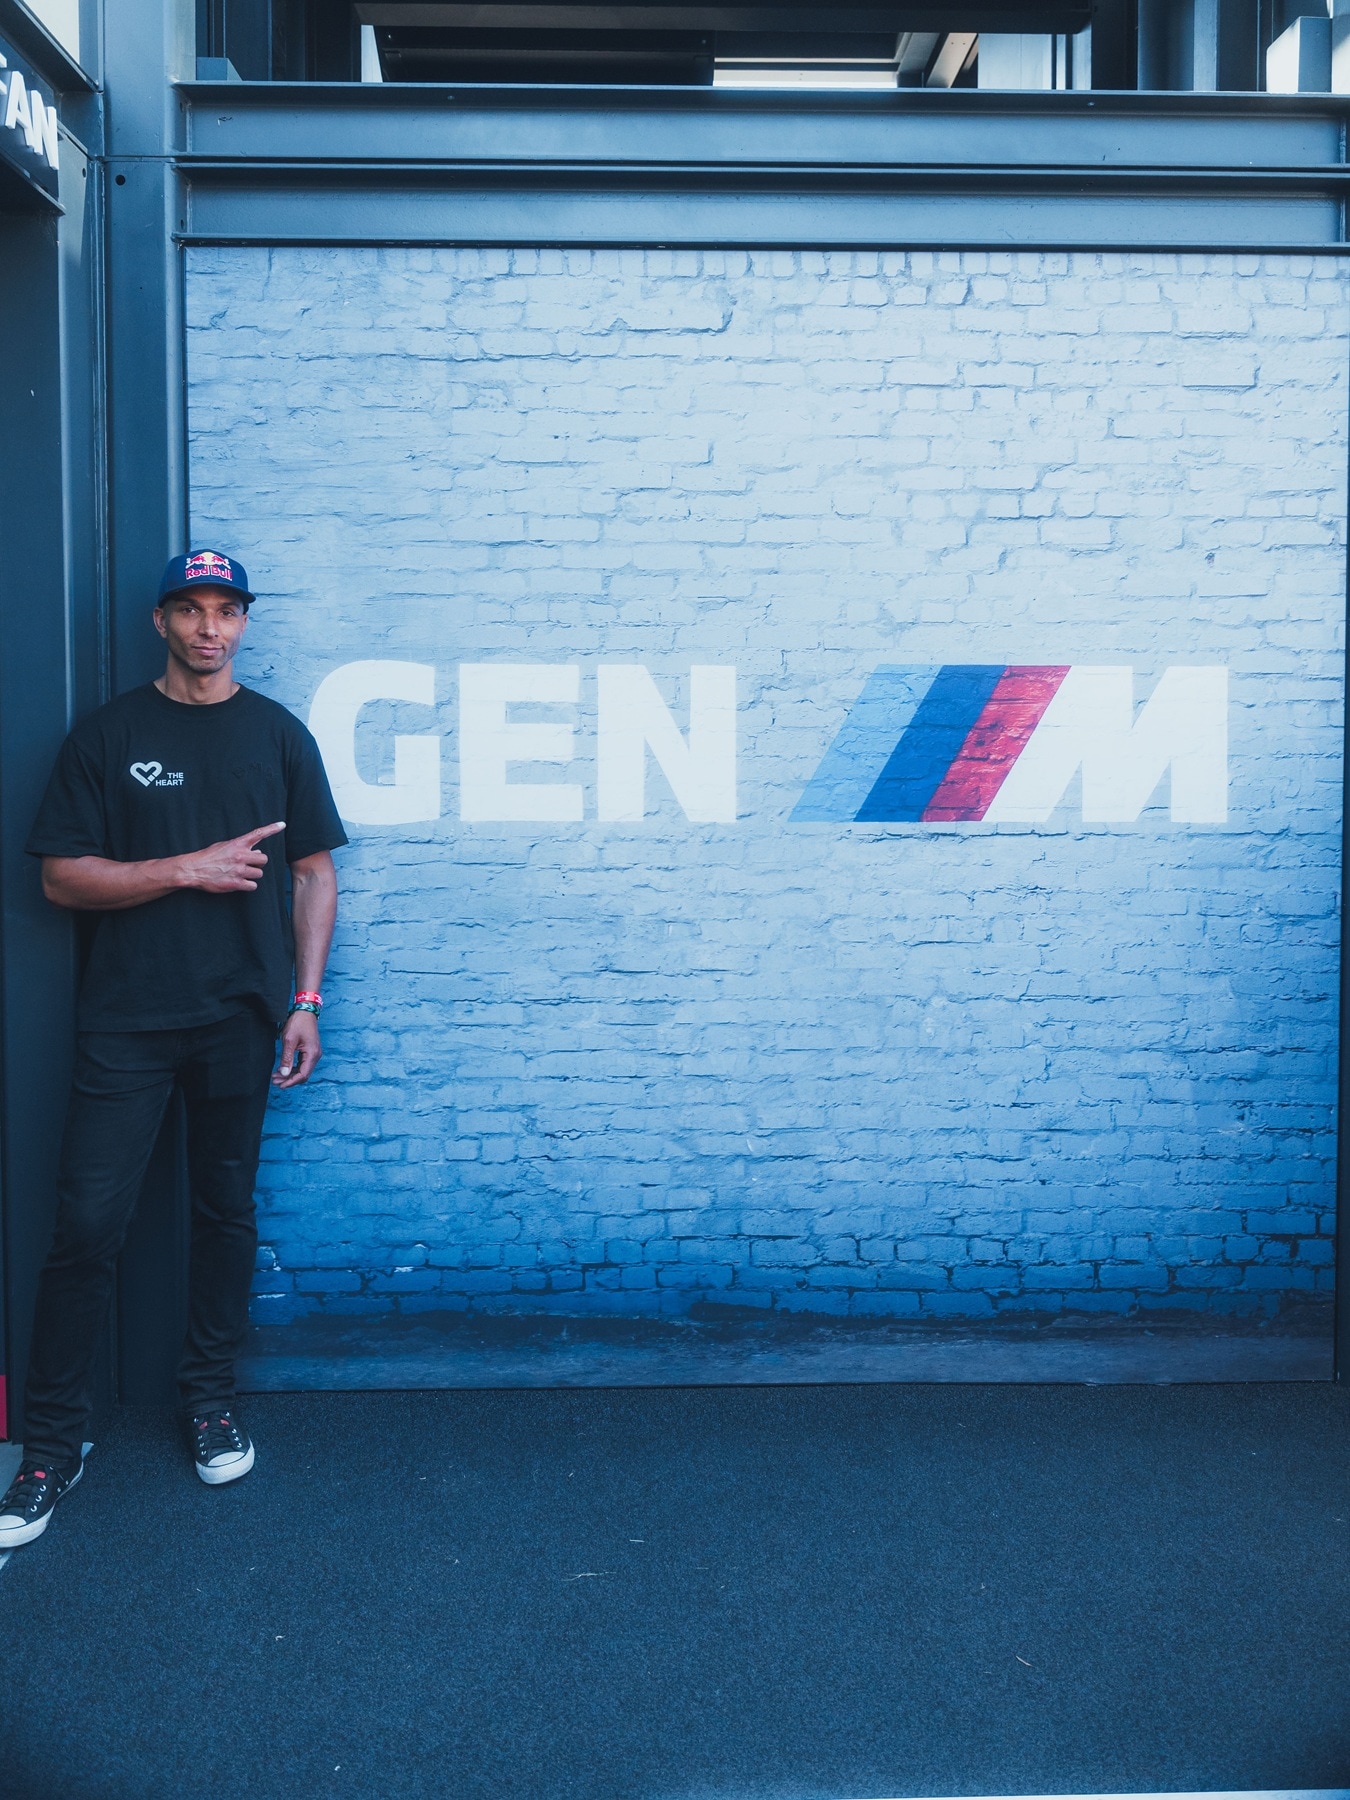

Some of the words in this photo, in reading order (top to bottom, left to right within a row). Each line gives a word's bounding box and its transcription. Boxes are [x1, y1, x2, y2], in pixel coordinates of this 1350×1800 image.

[185, 565, 210, 580] Red
[210, 565, 233, 581] Bull
[308, 660, 738, 825] GEN
[155, 779, 184, 787] HEART
